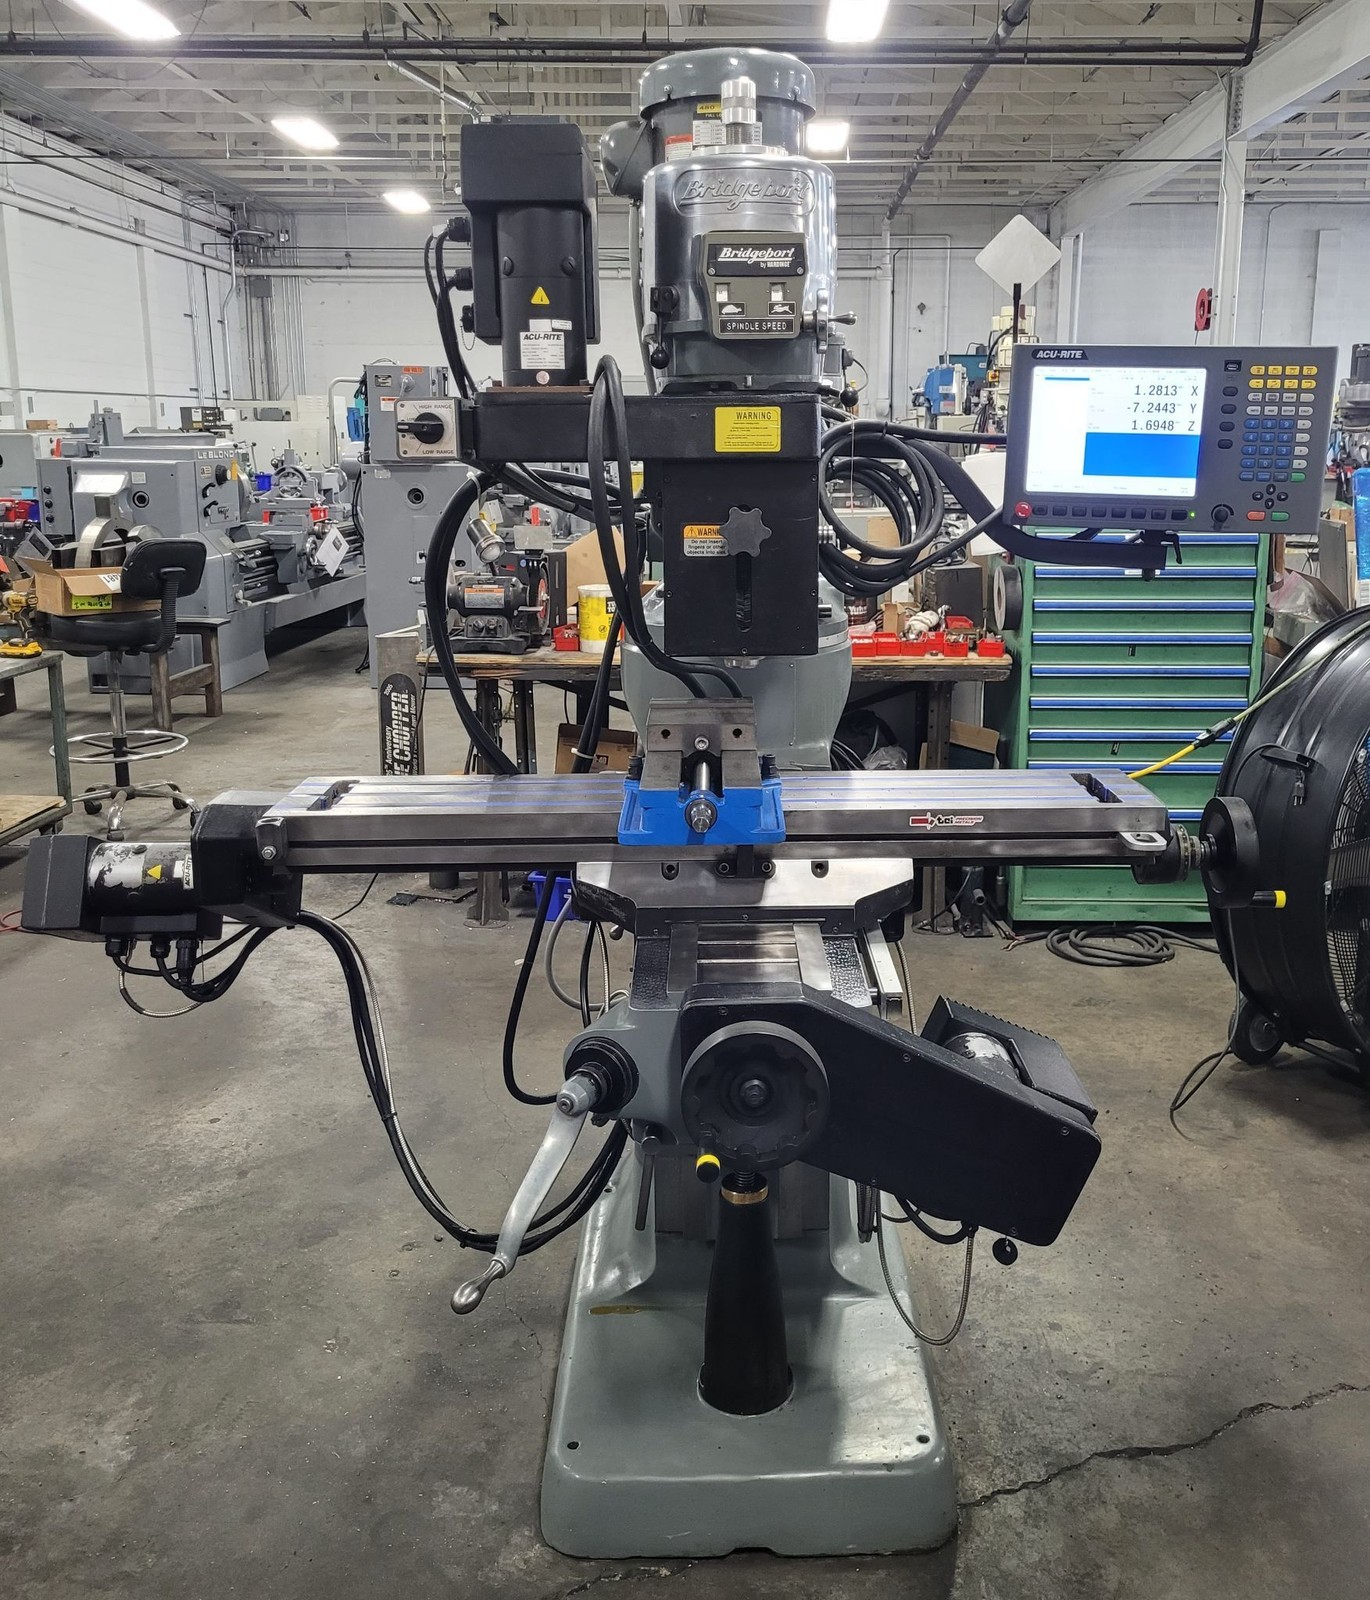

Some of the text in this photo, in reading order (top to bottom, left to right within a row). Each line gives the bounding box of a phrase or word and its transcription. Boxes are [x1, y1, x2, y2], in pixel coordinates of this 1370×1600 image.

[682, 178, 810, 210] Bridgeport
[718, 247, 795, 265] Bridgeport
[726, 321, 787, 331] SPINDLE SPEED
[523, 333, 563, 341] ACU-RITE
[1036, 350, 1083, 359] ACU-RITE
[1134, 384, 1199, 396] 1.2813 X
[1127, 402, 1197, 414] -7.2443 Y
[736, 411, 772, 420] WARNING
[1131, 419, 1195, 431] 1.6948 Z
[697, 528, 720, 536] WARNI
[391, 692, 411, 762] CHOPPER
[385, 725, 393, 765] Anniversary
[937, 816, 953, 824] tci
